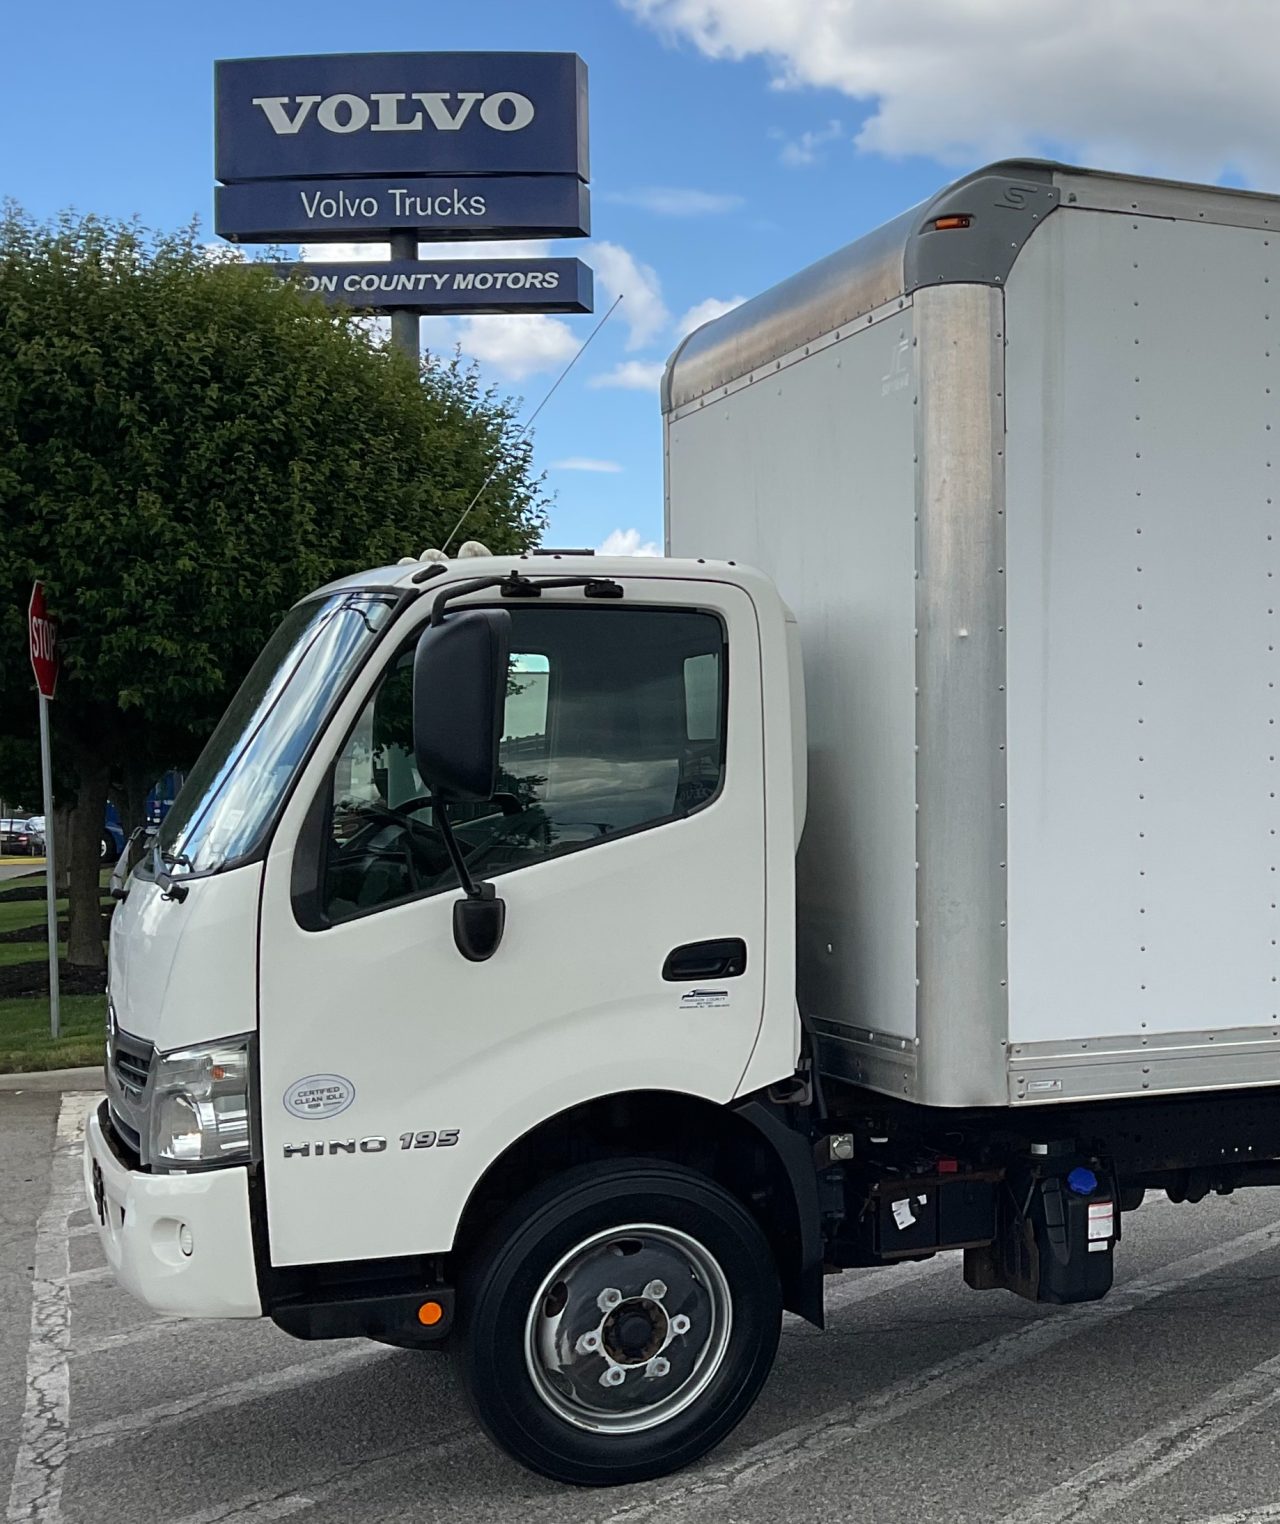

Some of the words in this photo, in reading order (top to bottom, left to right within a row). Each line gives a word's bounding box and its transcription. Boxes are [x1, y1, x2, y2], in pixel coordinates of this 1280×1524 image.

[252, 92, 534, 134] VOLVO
[301, 191, 378, 218] Volvo
[388, 189, 486, 216] Trucks
[343, 274, 449, 291] COUNTY
[453, 272, 559, 290] MOTORS
[33, 616, 56, 661] STOP
[294, 1096, 323, 1105] CLEAN
[326, 1093, 344, 1101] IDLE
[298, 1086, 340, 1098] CERTIFIED
[283, 1136, 387, 1158] HINO
[400, 1129, 460, 1150] 195
